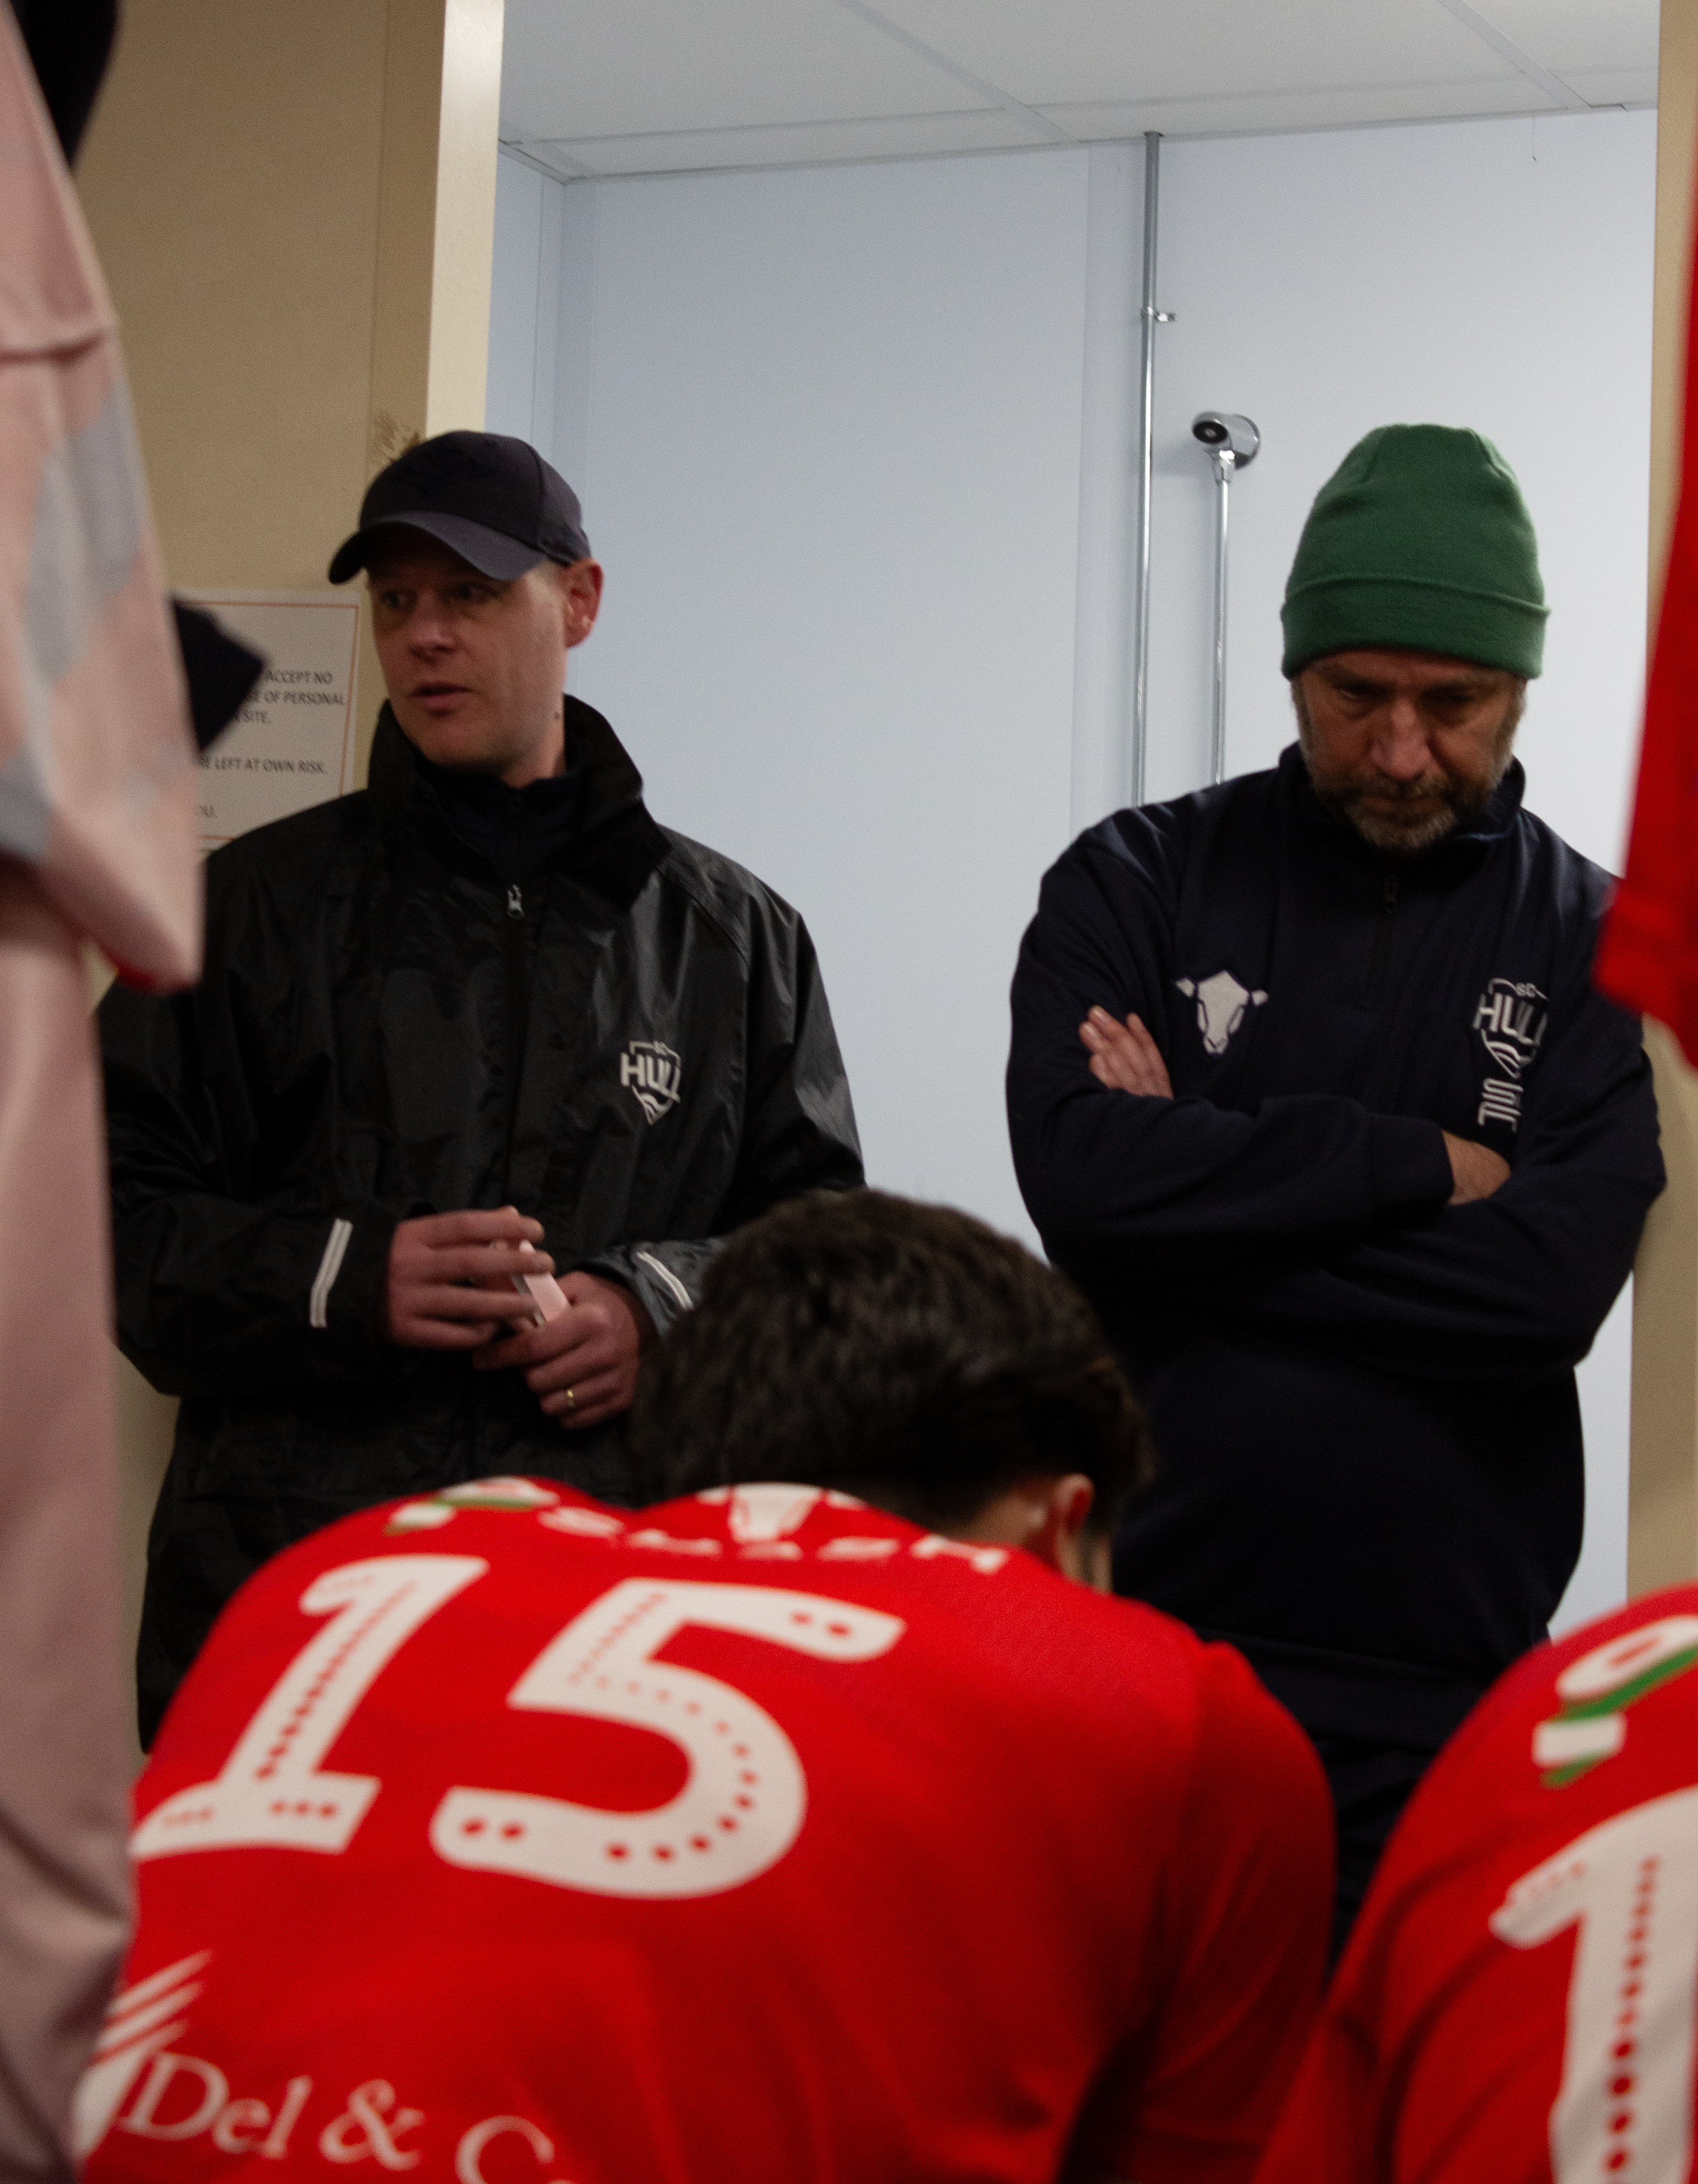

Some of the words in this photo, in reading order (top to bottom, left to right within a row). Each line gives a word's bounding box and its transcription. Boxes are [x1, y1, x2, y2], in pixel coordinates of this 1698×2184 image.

[265, 670, 310, 684] ACCEPT
[313, 671, 333, 684] NO
[264, 691, 282, 704] OF
[284, 692, 345, 705] PERSONAL
[214, 757, 241, 770] LEFT
[244, 758, 261, 771] AT
[263, 759, 295, 772] OWN
[128, 1553, 906, 1901] 15
[117, 2048, 313, 2160] Del
[318, 2078, 426, 2171] &
[455, 2114, 584, 2184] C
